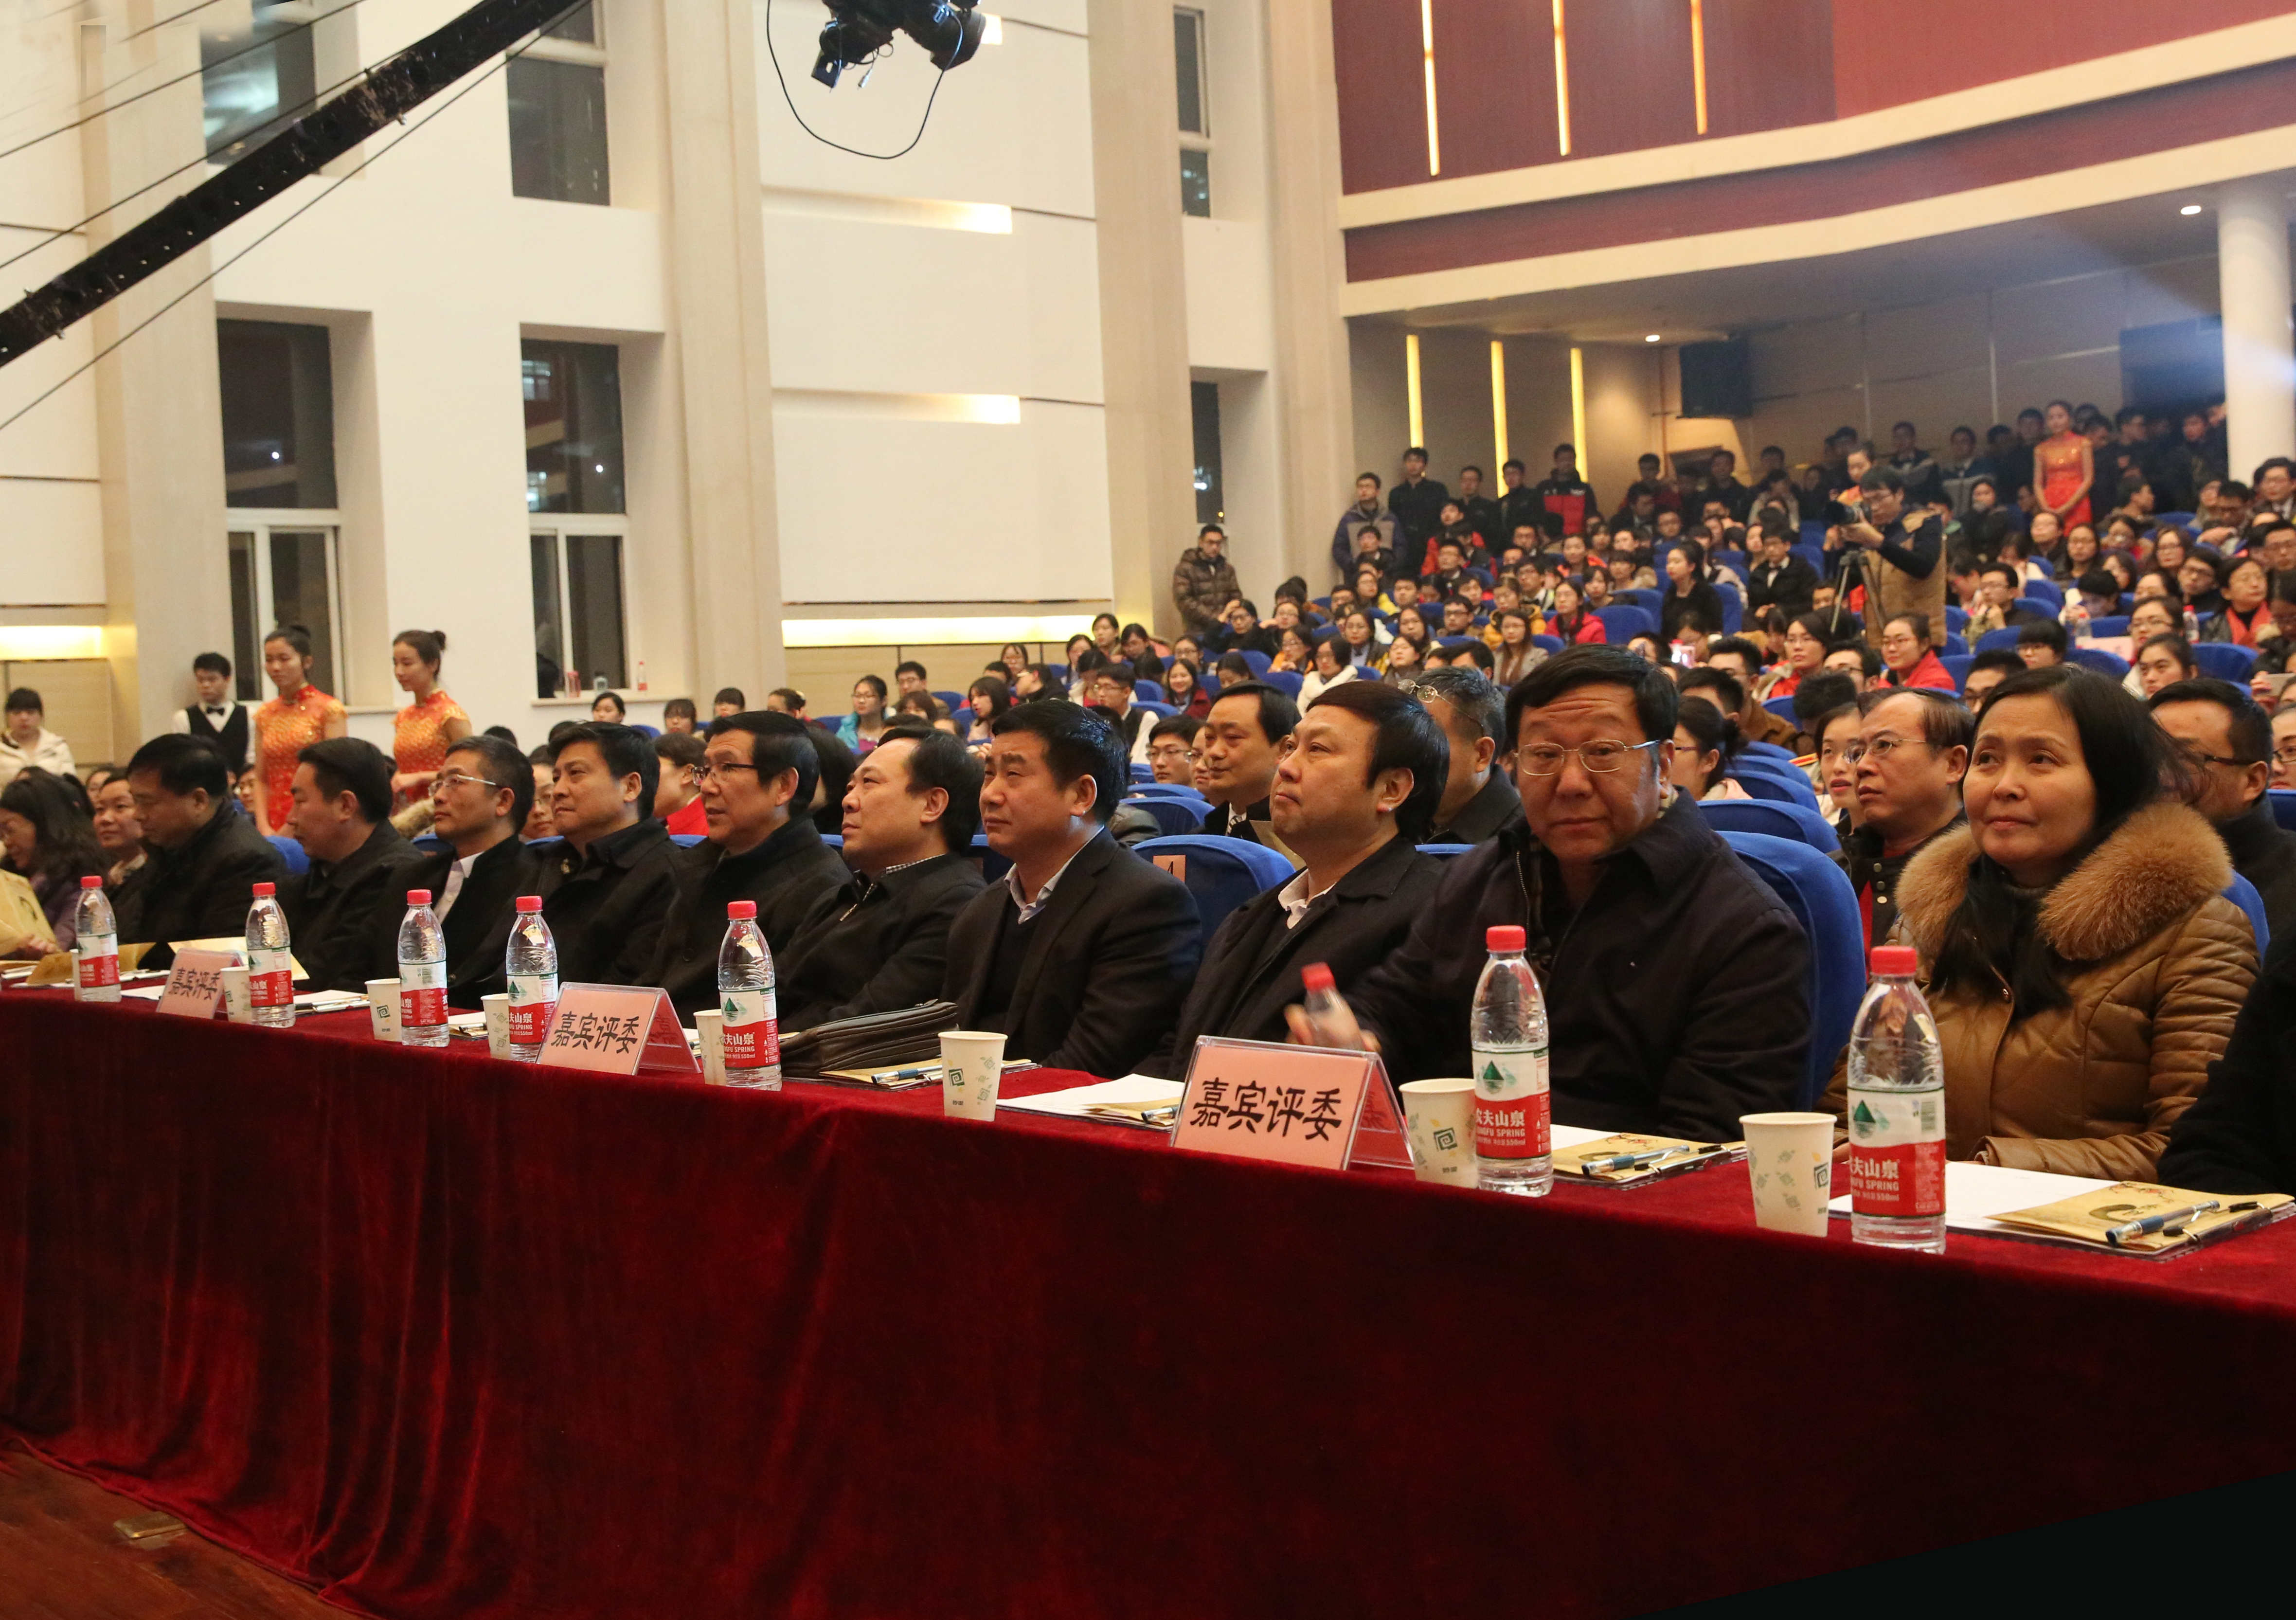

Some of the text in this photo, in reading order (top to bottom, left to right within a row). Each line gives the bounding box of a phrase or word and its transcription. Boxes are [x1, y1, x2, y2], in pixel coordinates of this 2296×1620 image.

[551, 1010, 640, 1054] 嘉宾评委
[724, 1032, 754, 1045] 夫山泉
[1190, 1077, 1342, 1141] 嘉宾评委
[1496, 1128, 1525, 1137] SPRING
[1866, 1180, 1899, 1191] SPRING
